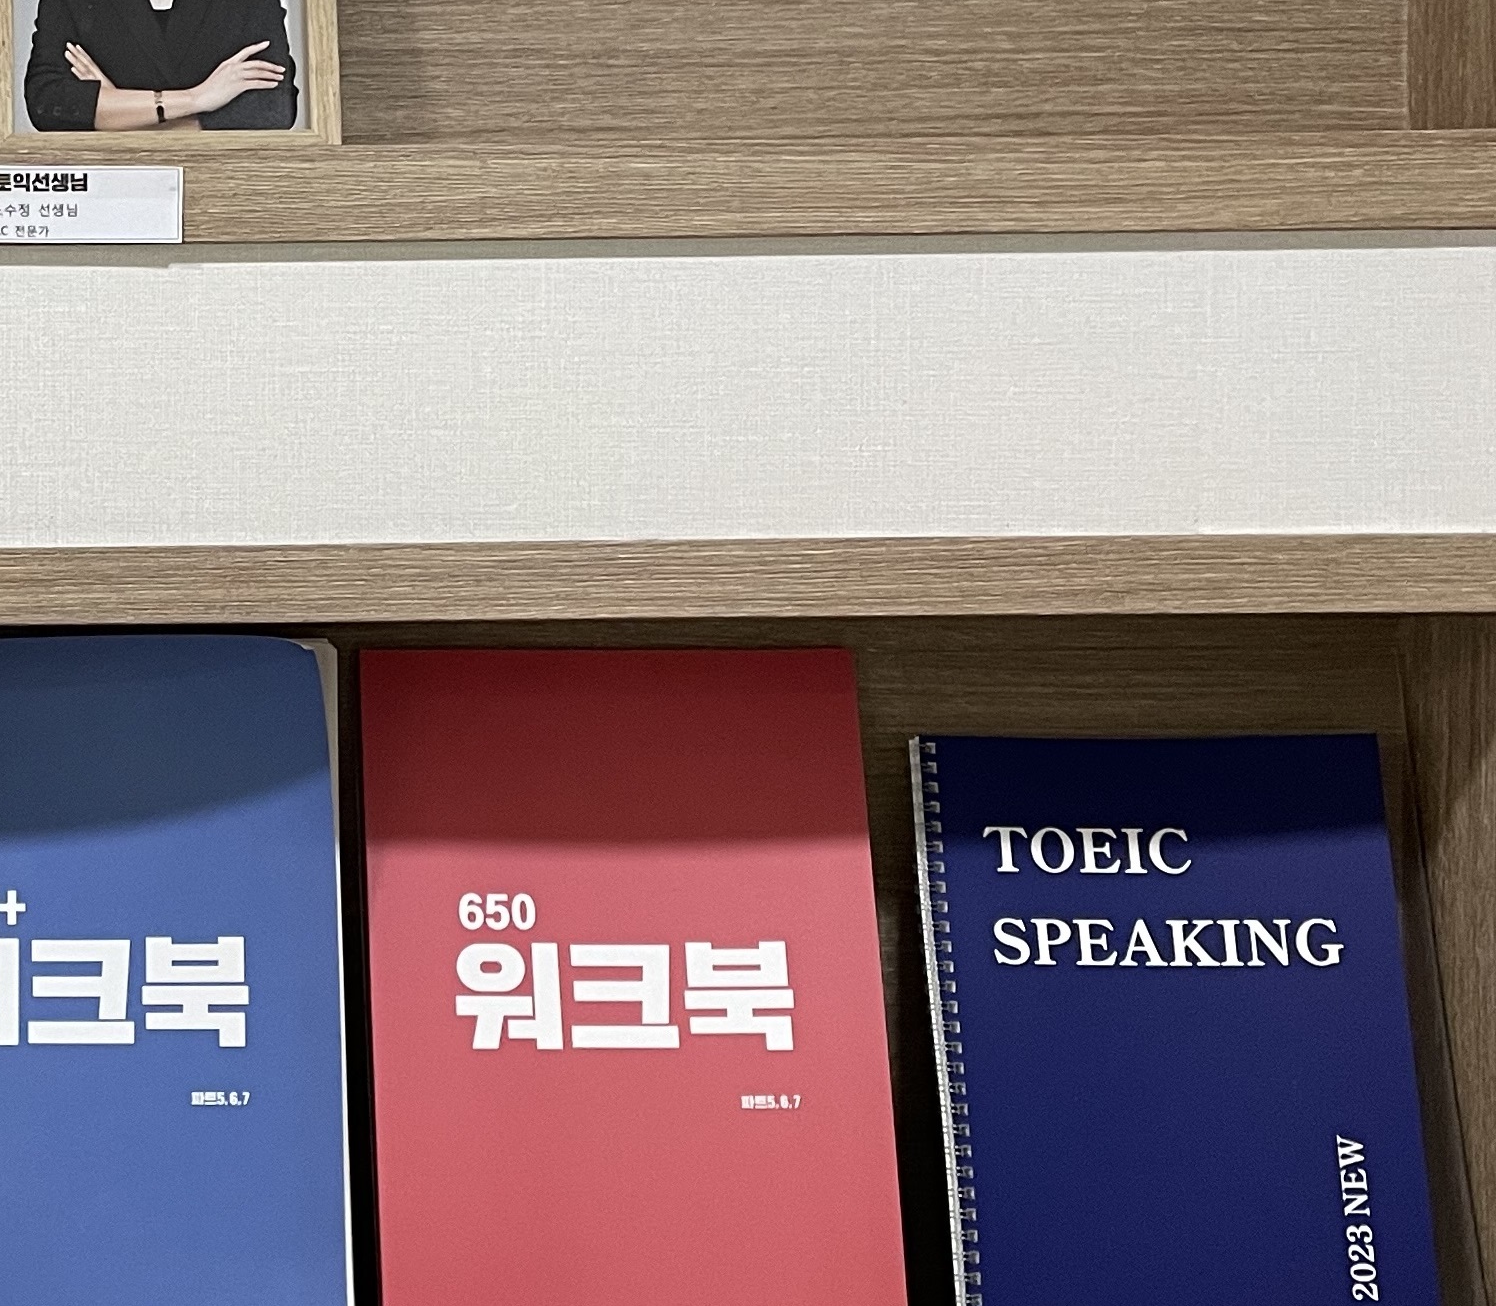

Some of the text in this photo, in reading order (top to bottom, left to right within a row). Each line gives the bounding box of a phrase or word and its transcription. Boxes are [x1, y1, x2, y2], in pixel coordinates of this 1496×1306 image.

[15, 225, 50, 238] 전문가
[38, 203, 78, 218] 선생님
[982, 825, 1192, 875] TOEIC
[458, 893, 537, 931] 650
[993, 917, 1345, 968] SPEAKING
[455, 940, 796, 1052] 워크북
[1336, 1134, 1379, 1302] 2023 NEW
